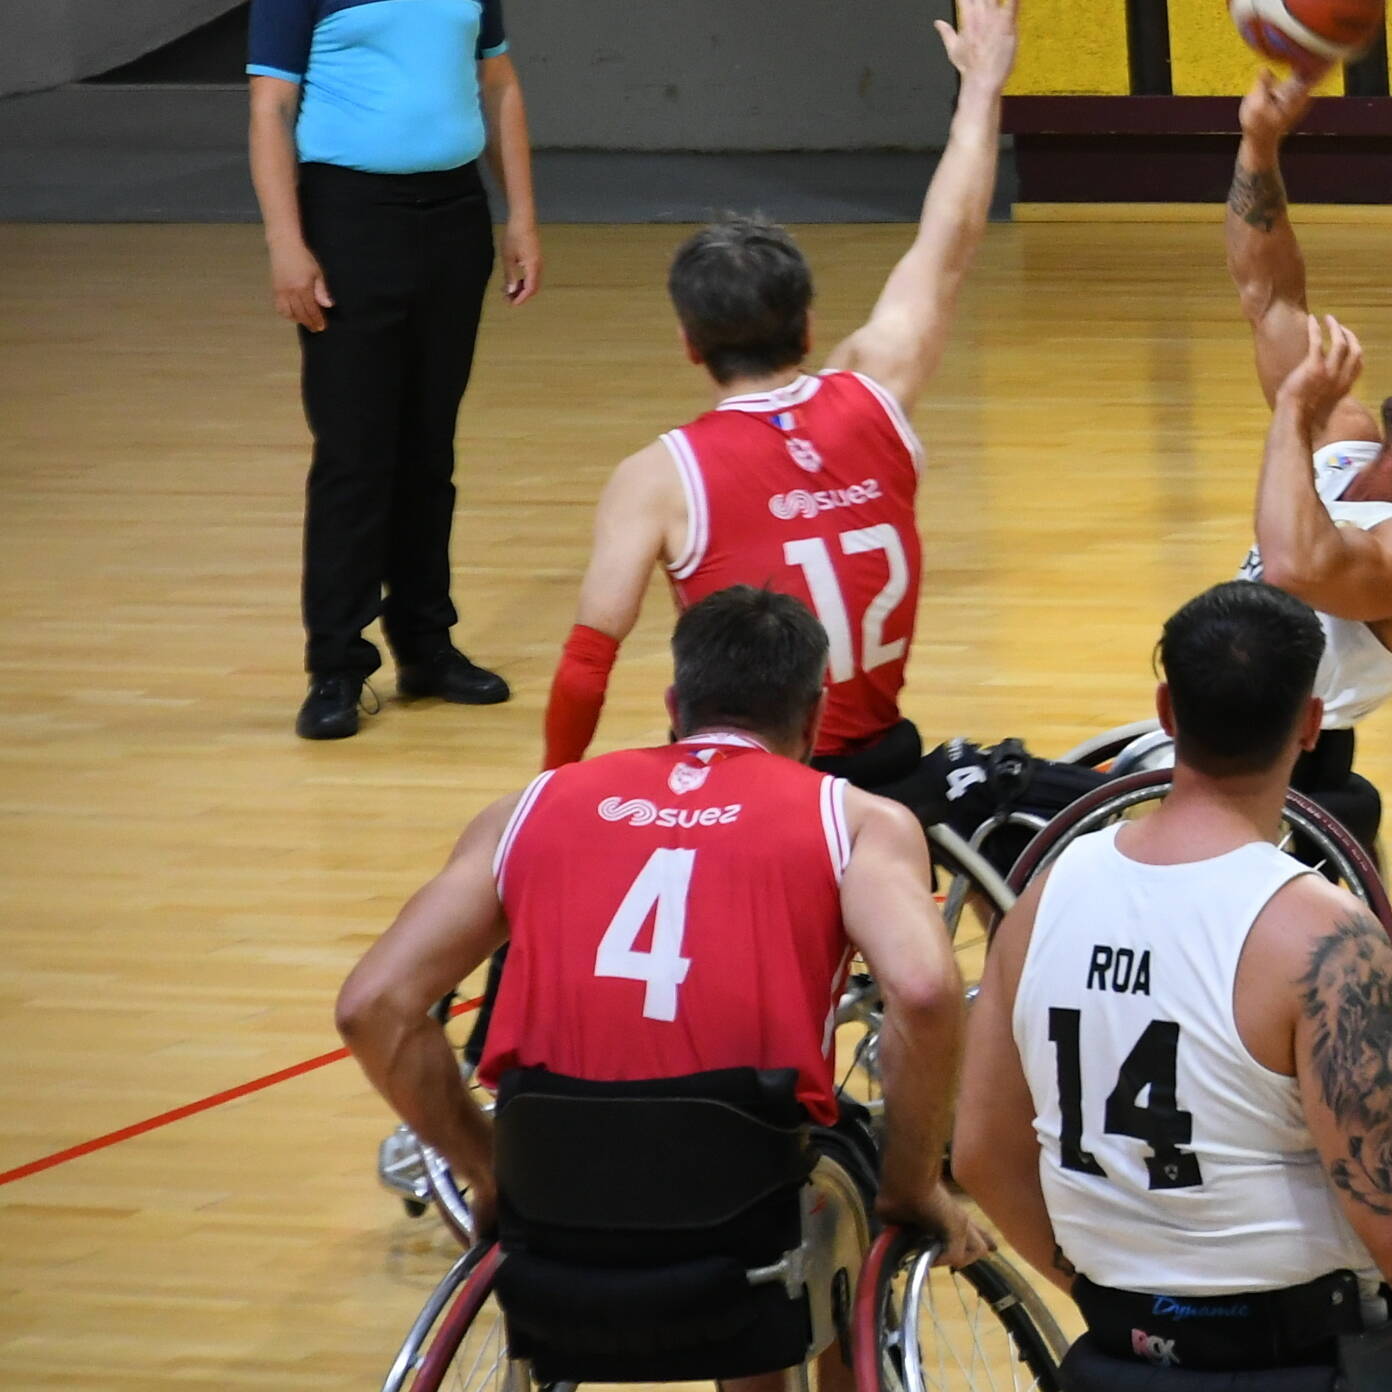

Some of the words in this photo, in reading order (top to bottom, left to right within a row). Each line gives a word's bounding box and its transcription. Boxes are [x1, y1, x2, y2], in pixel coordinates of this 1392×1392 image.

[813, 478, 883, 510] suez
[782, 522, 910, 684] 12
[655, 803, 742, 828] suez
[593, 847, 698, 1022] 4
[1086, 944, 1152, 996] ROA
[1047, 1006, 1204, 1191] 14
